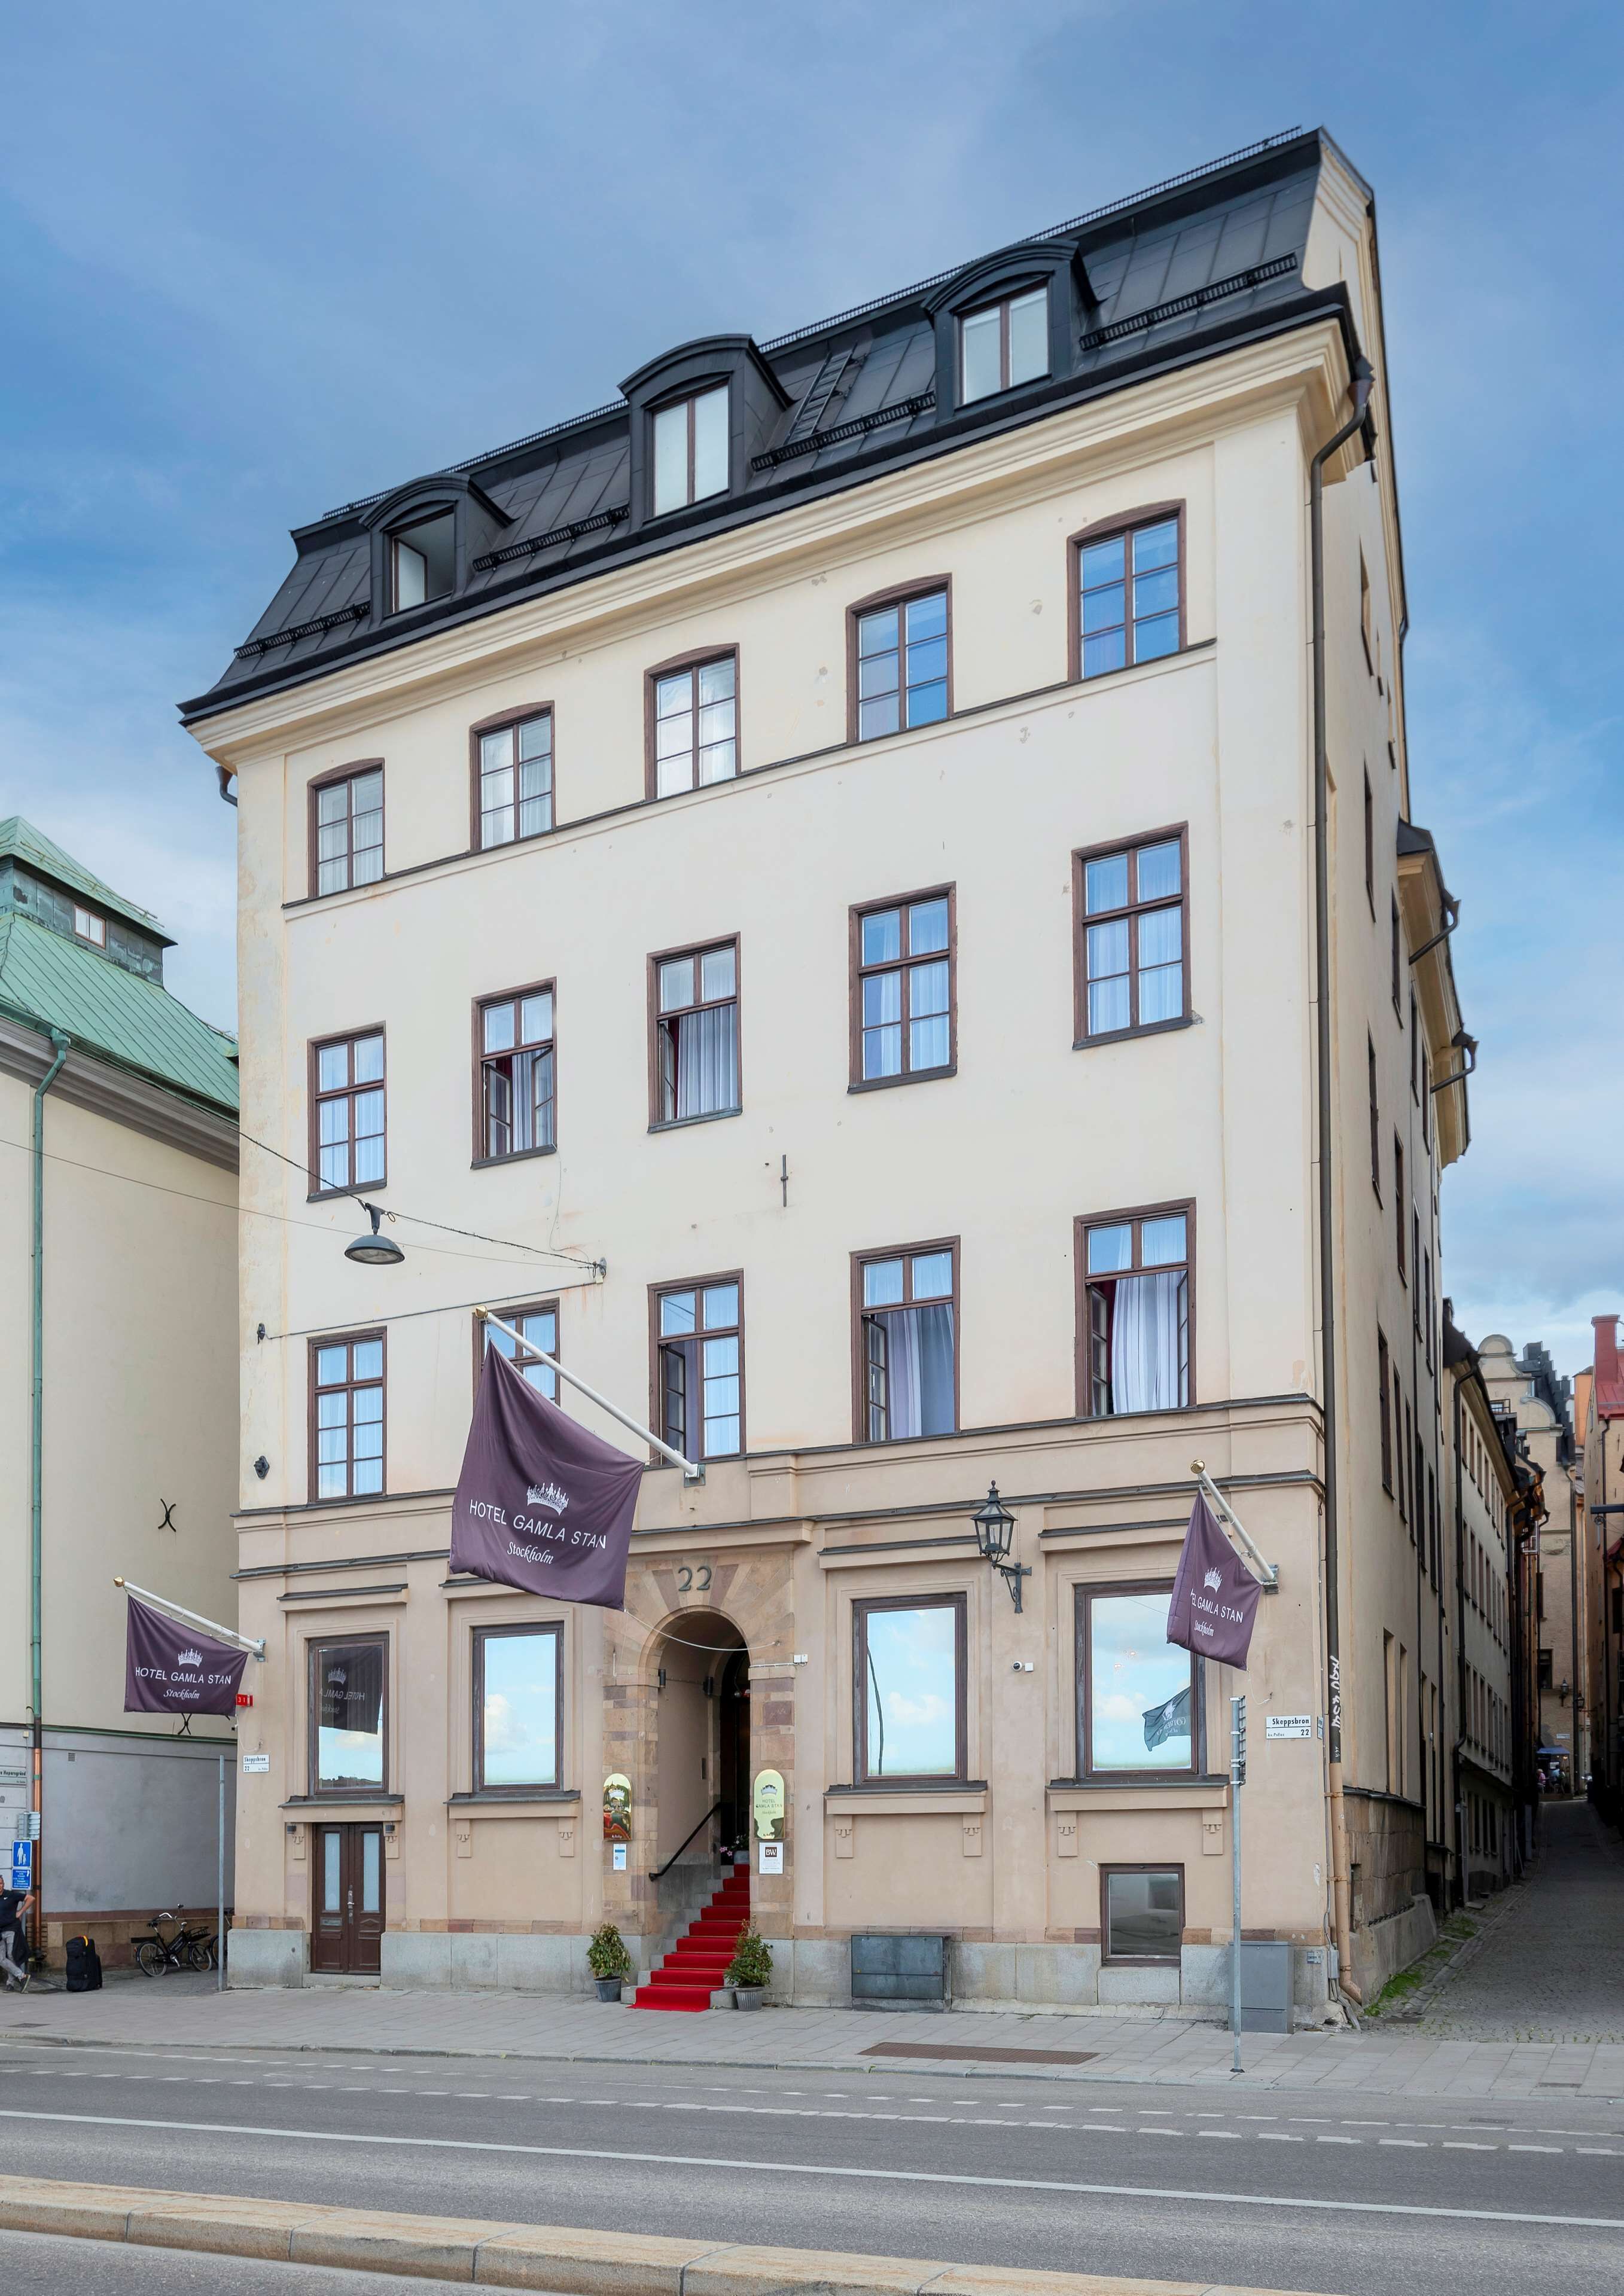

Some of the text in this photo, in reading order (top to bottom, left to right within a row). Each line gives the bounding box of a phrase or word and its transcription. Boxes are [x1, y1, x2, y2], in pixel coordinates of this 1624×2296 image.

[470, 1499, 607, 1549] HOTEL GAMLA STAN
[507, 1541, 554, 1565] Stockholm
[678, 1565, 712, 1591] 22
[1198, 1596, 1219, 1616] GAMLA
[1220, 1606, 1243, 1623] STAN
[1194, 1620, 1214, 1636] Stockholm
[135, 1667, 231, 1685] HOTEL GAMLA STAN
[163, 1688, 200, 1700] Stockholm
[1272, 1718, 1309, 1727] Skeppsbron
